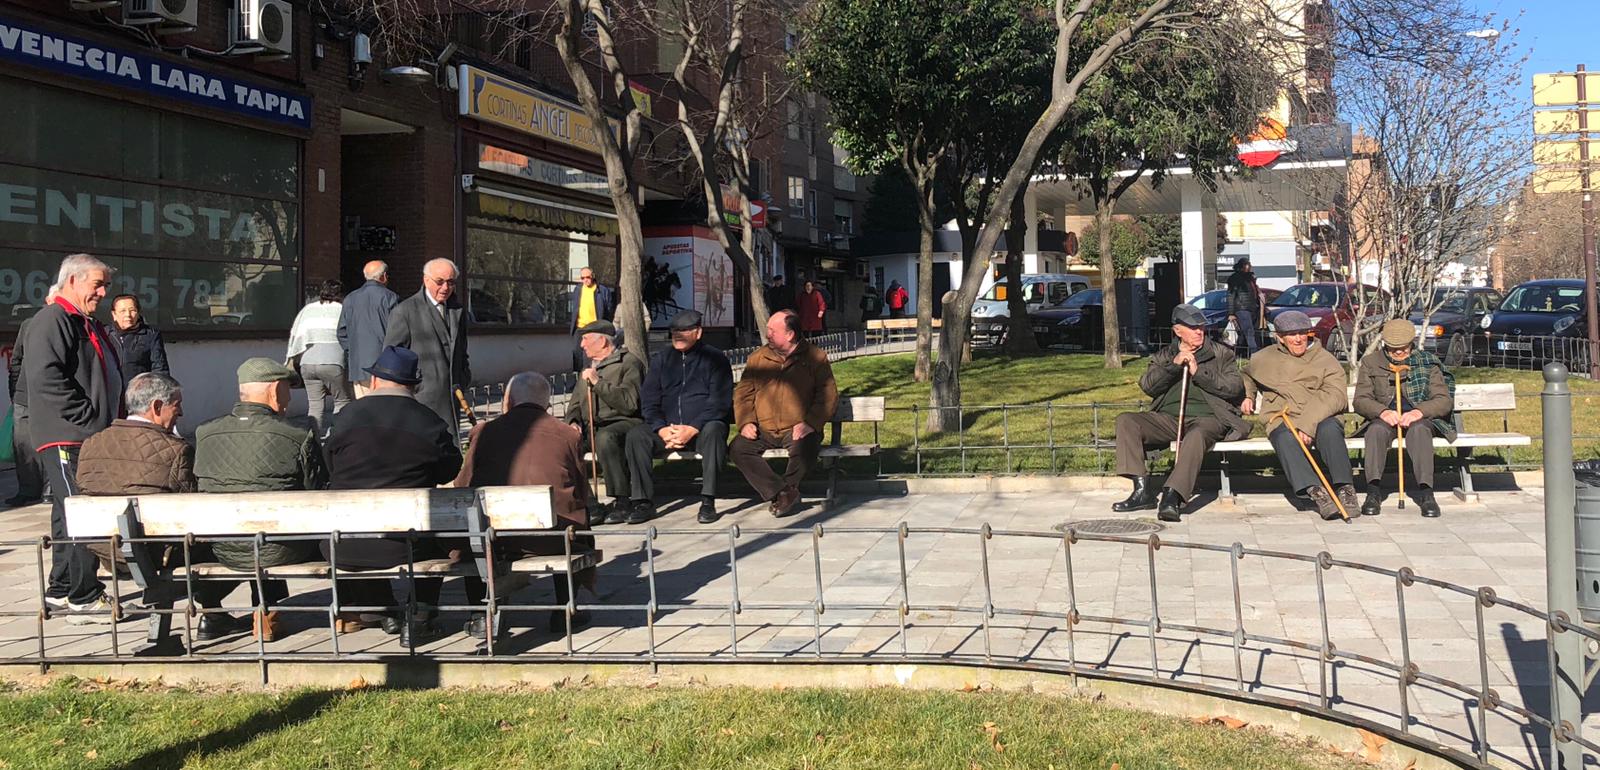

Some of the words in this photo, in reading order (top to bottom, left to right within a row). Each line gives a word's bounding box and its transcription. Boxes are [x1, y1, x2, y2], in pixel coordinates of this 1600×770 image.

[0, 24, 141, 80] VENECIA
[151, 64, 226, 100] LARA
[234, 84, 304, 120] TAPIA
[487, 93, 527, 127] CORTINAS
[530, 100, 571, 140] ANGEL
[0, 183, 256, 242] ENTISTA
[0, 267, 57, 307] 96
